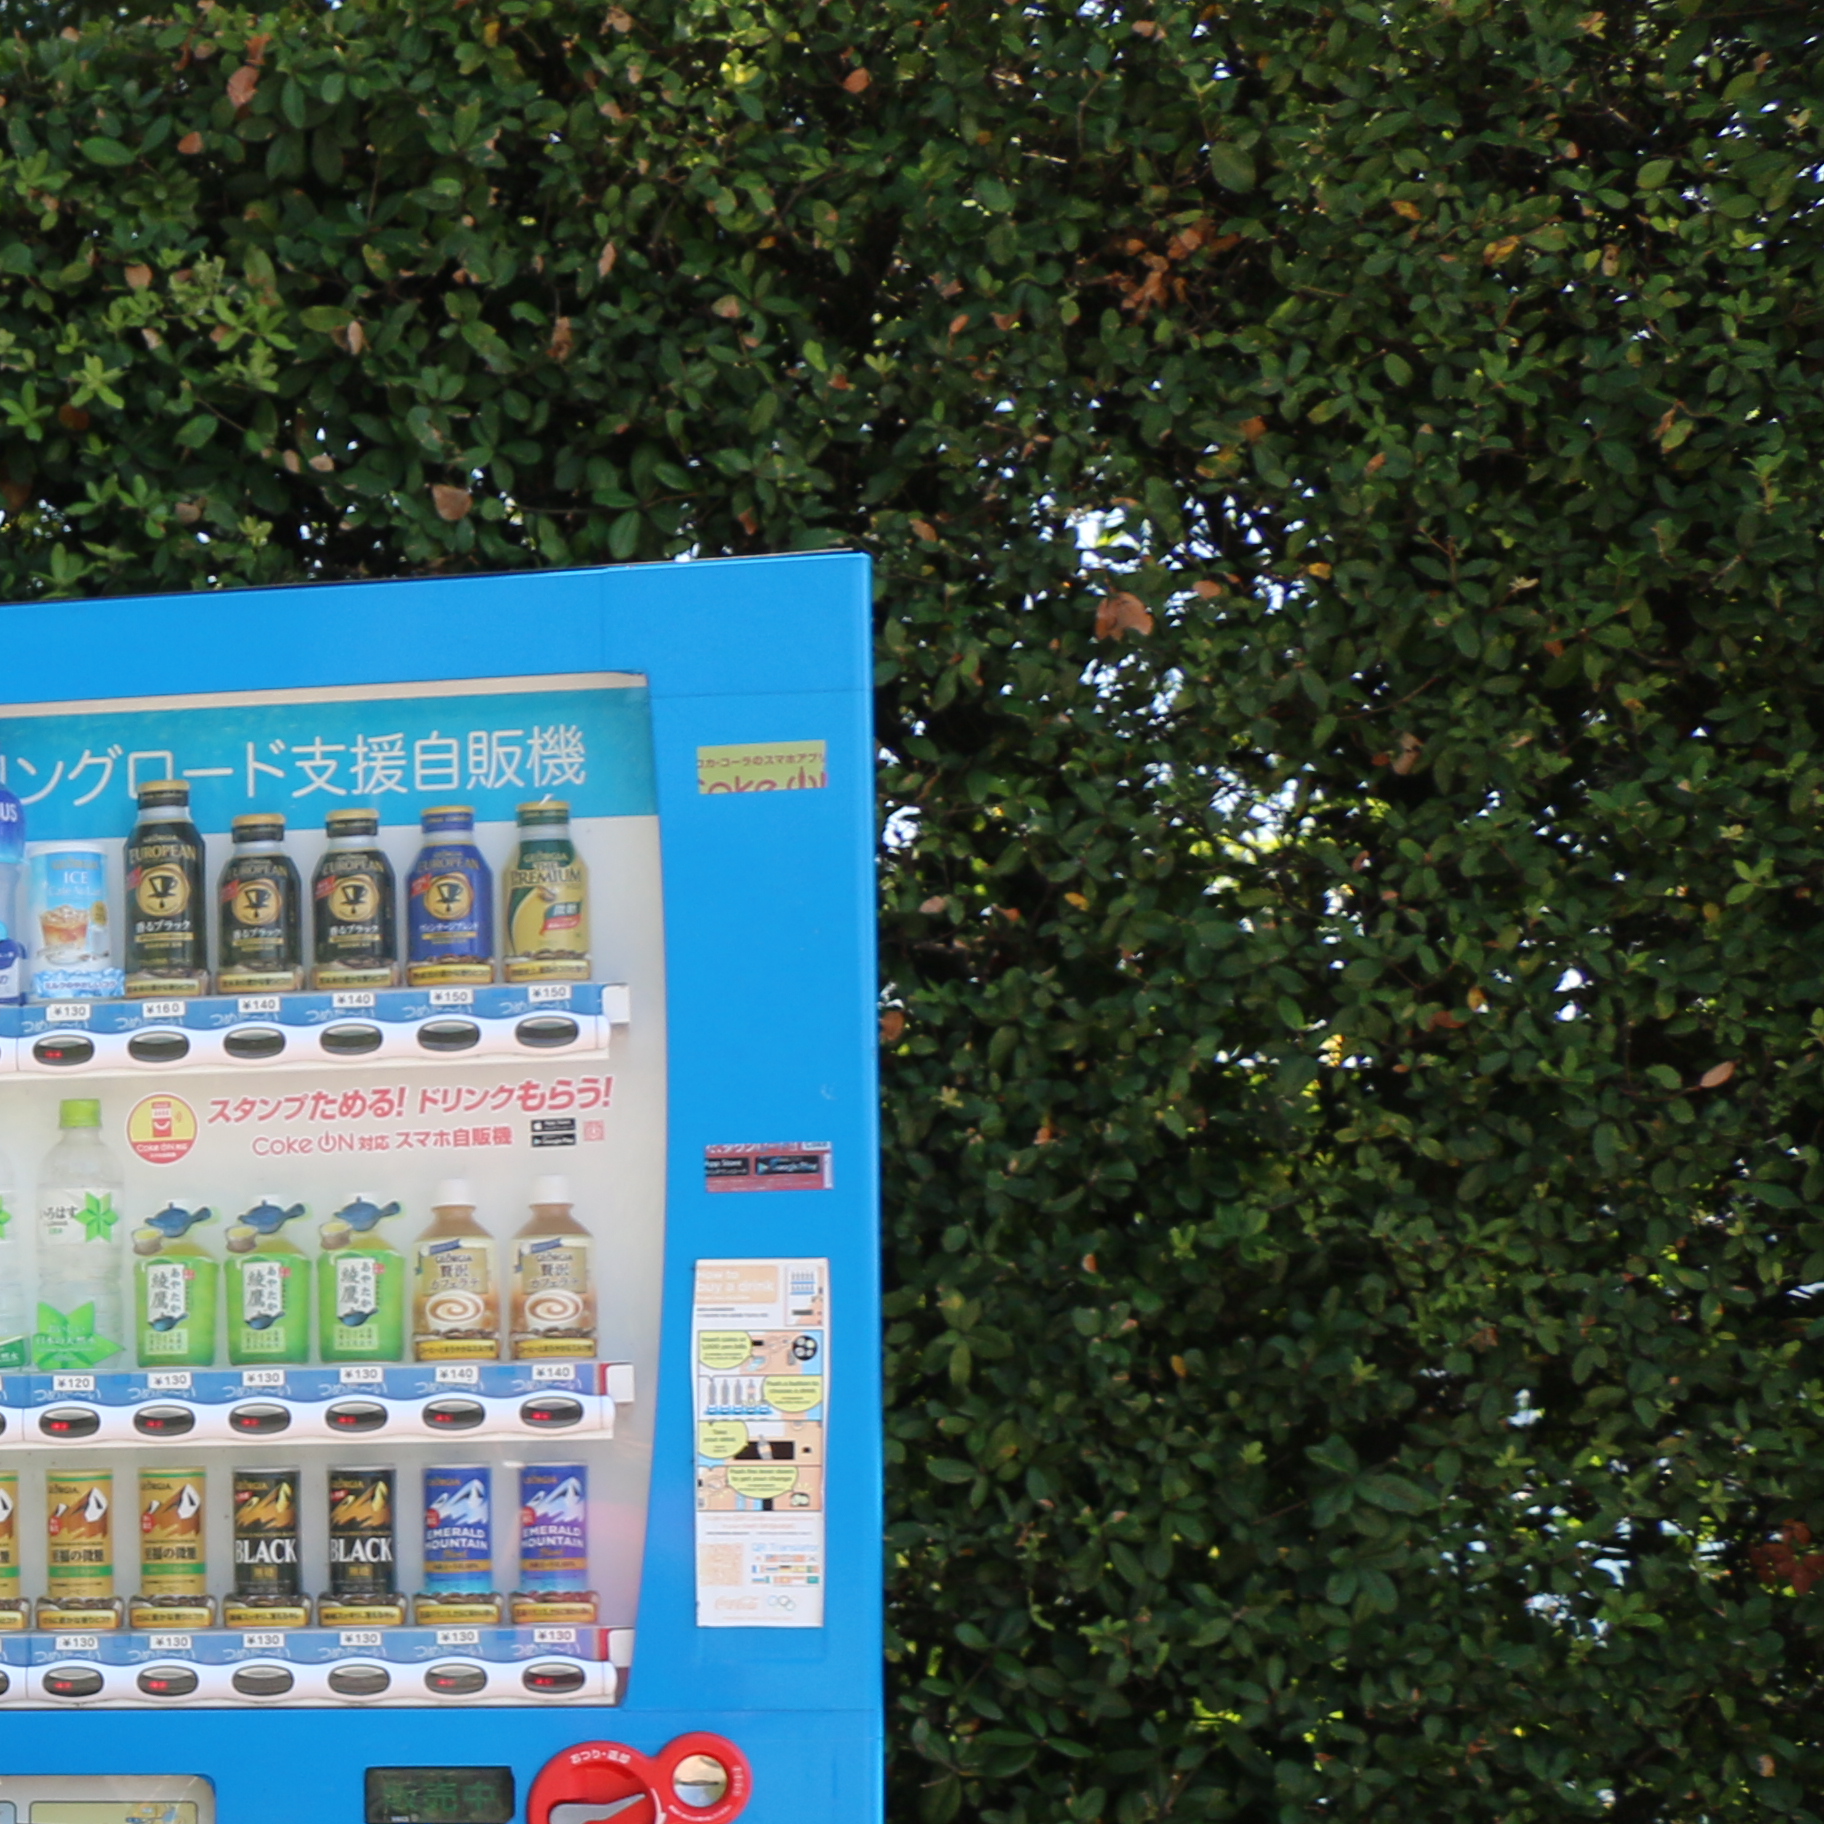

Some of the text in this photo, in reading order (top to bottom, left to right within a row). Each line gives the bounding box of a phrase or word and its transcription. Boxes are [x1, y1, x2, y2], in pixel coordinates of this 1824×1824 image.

[63, 871, 89, 885] ICE
[510, 869, 581, 884] PREMIUM
[434, 991, 468, 1002] ¥150
[533, 987, 566, 998] ¥150
[243, 1000, 276, 1010] ¥140
[337, 994, 370, 1005] ¥140
[54, 1006, 86, 1017] ¥130
[146, 1003, 179, 1014] ¥160
[207, 1076, 613, 1125] スタンプためる! ドリンクもらう!
[251, 1136, 313, 1158] Coke
[358, 1134, 389, 1152] 対応
[396, 1127, 513, 1150] スマホ自販機
[247, 1372, 280, 1384] ¥130
[344, 1368, 378, 1380] ¥130
[440, 1368, 473, 1380] ¥140
[536, 1366, 570, 1378] ¥140
[58, 1378, 90, 1389] ¥120
[154, 1374, 187, 1386] ¥130
[427, 1527, 485, 1539] EMERALD
[522, 1525, 582, 1537] EMERALD
[235, 1538, 297, 1563] BLACK
[331, 1537, 393, 1563] BLACK
[343, 1633, 377, 1644] ¥130
[440, 1631, 475, 1642] ¥130
[538, 1629, 572, 1641] ¥130
[156, 1636, 188, 1647] ¥130
